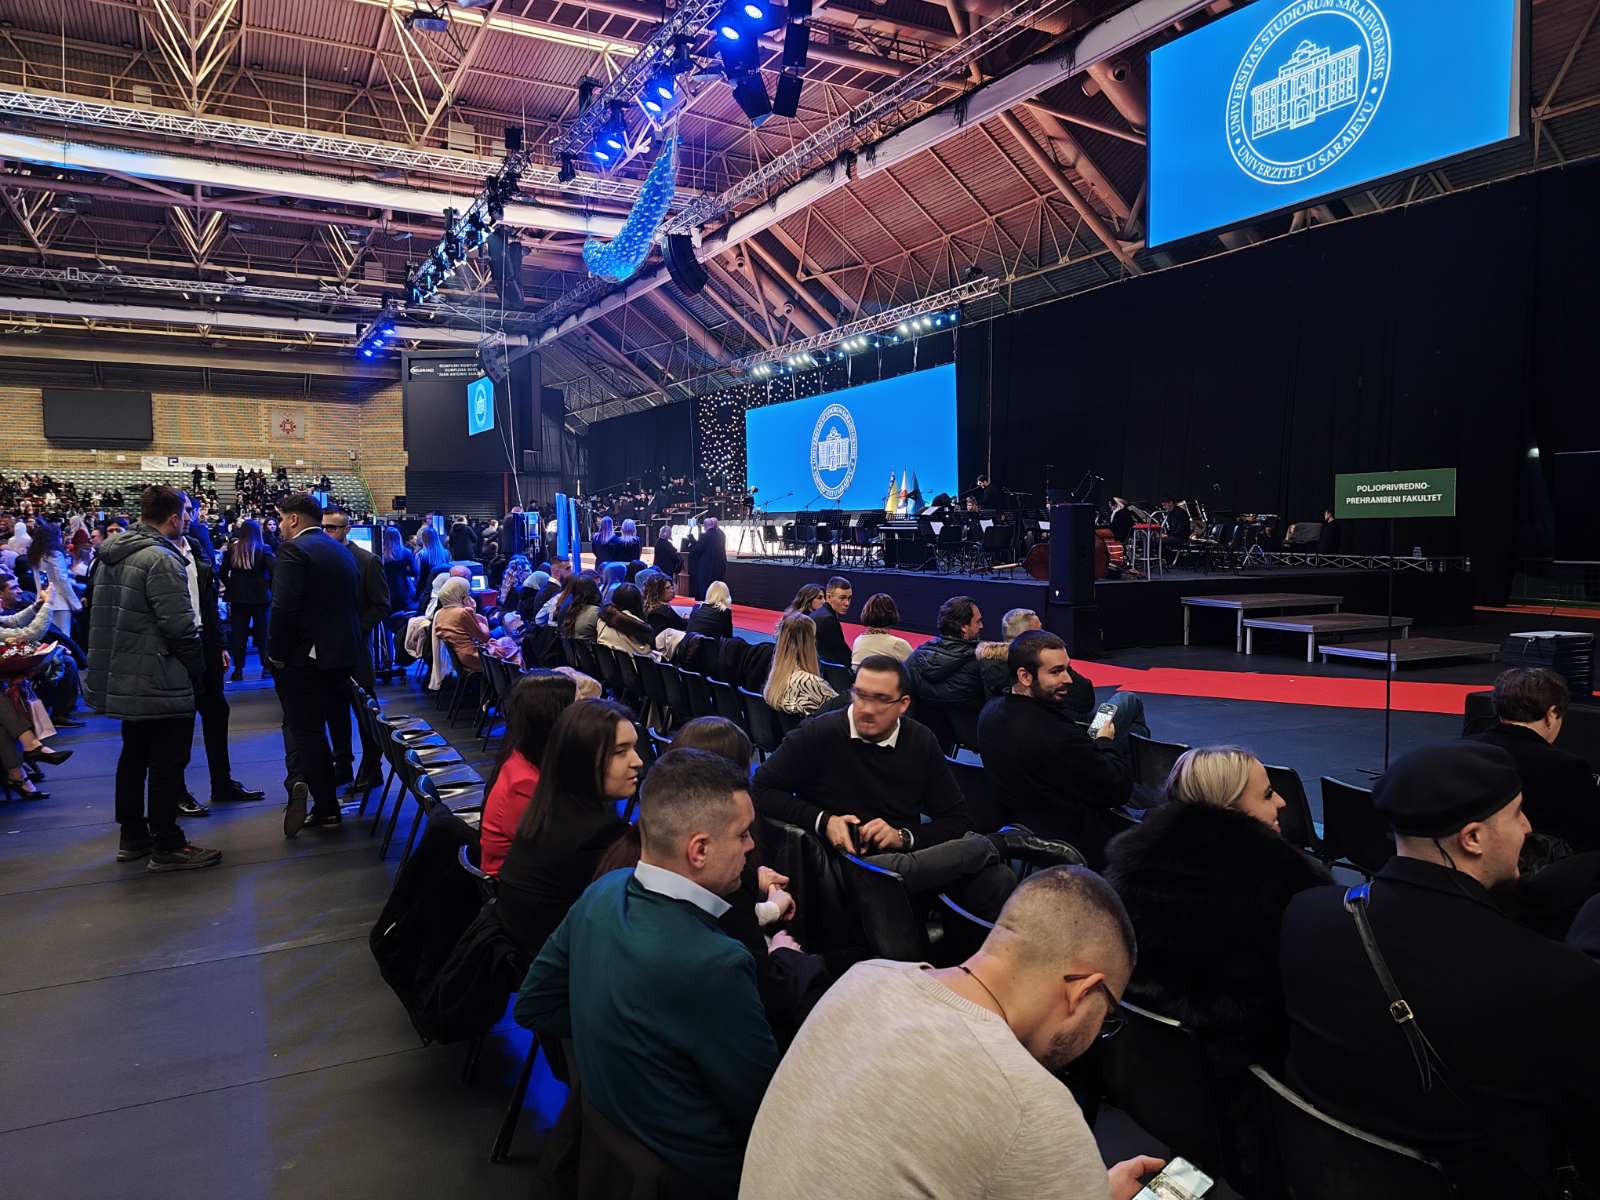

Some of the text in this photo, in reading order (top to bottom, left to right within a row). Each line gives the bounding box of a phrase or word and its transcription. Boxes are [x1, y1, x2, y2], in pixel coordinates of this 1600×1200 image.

[1230, 45, 1263, 136] UNIVERSITAS
[1261, 0, 1334, 44] STUDIORUM
[1237, 101, 1375, 179] UNIVERZITET U SARAJEVU
[1346, 494, 1443, 504] PREHRAMBENI FAKULTET
[1356, 482, 1431, 492] POLJOPRIVREDNO-
